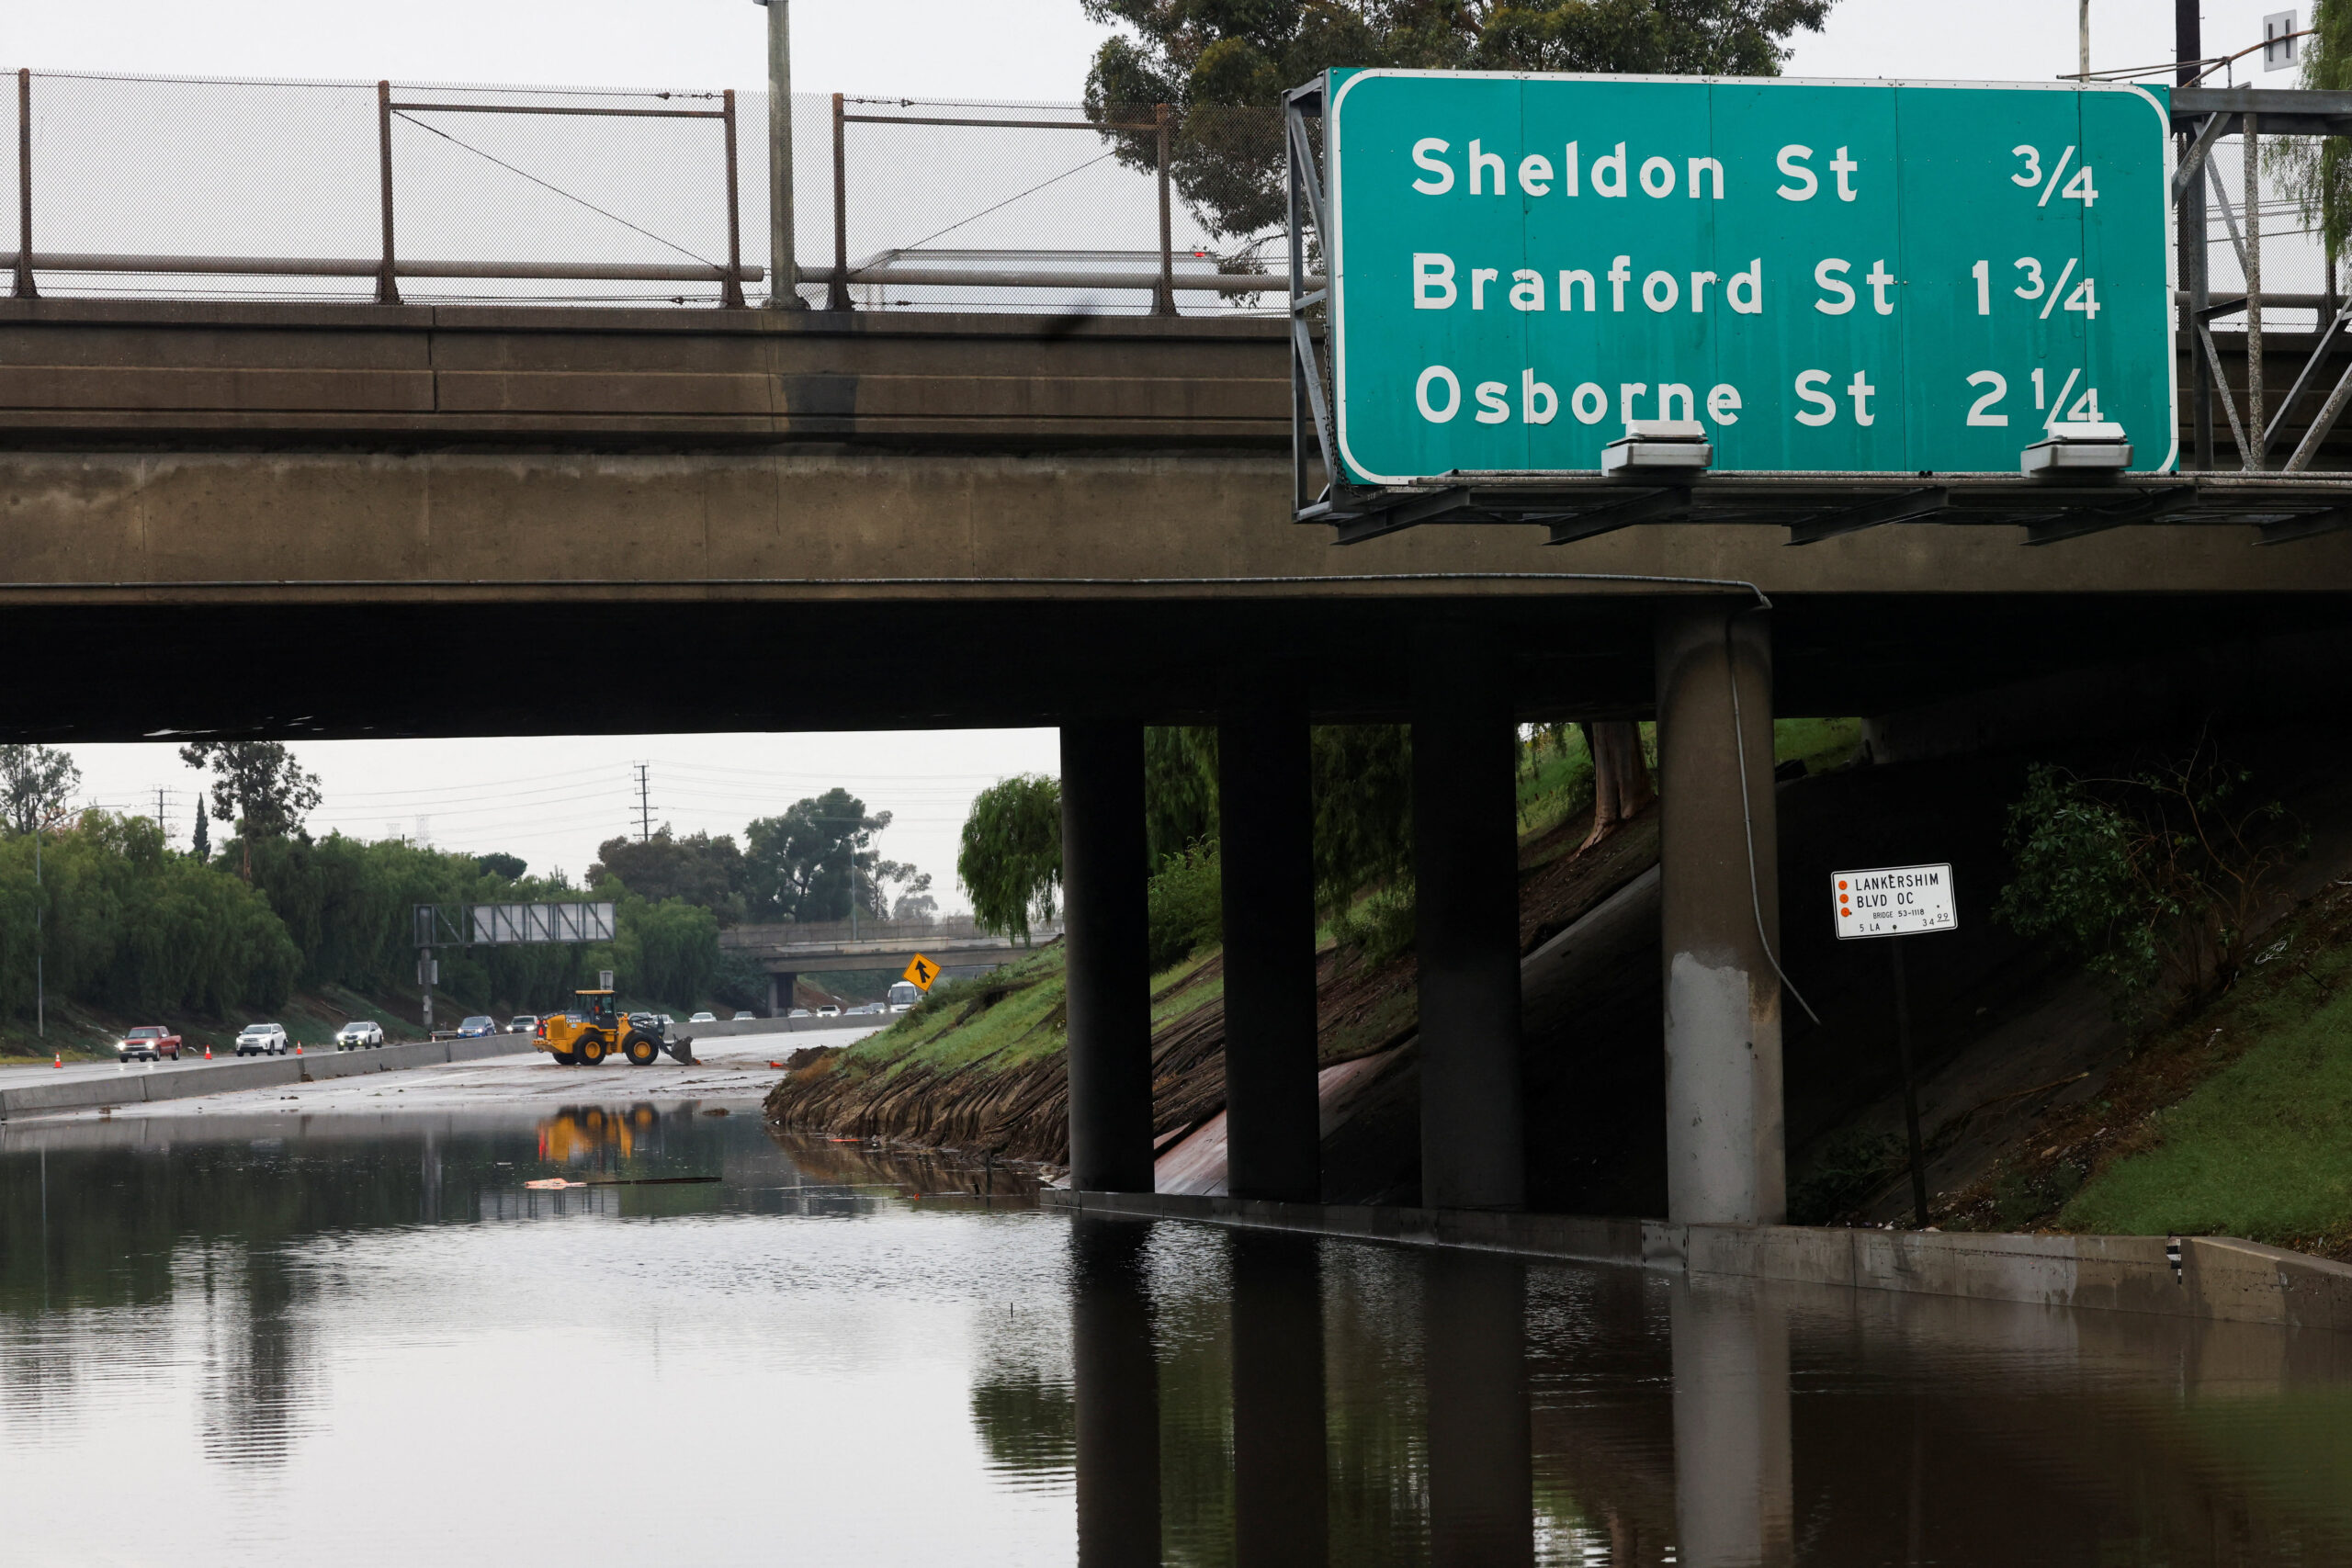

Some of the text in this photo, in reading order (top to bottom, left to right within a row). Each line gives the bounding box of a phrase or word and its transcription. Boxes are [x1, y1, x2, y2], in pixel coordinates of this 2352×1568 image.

[1412, 138, 2099, 208] Sheldon St 3/4
[1413, 253, 1762, 314] Branford
[1815, 258, 1894, 316] St
[1416, 366, 1742, 426] Osborne
[1795, 369, 1875, 427] St
[1855, 873, 1939, 891] LANKERSHIM
[1857, 892, 1914, 908] BLVD OC
[1898, 908, 1925, 918] 53-1118
[1860, 923, 1865, 932] 5
[1870, 923, 1881, 931] LA
